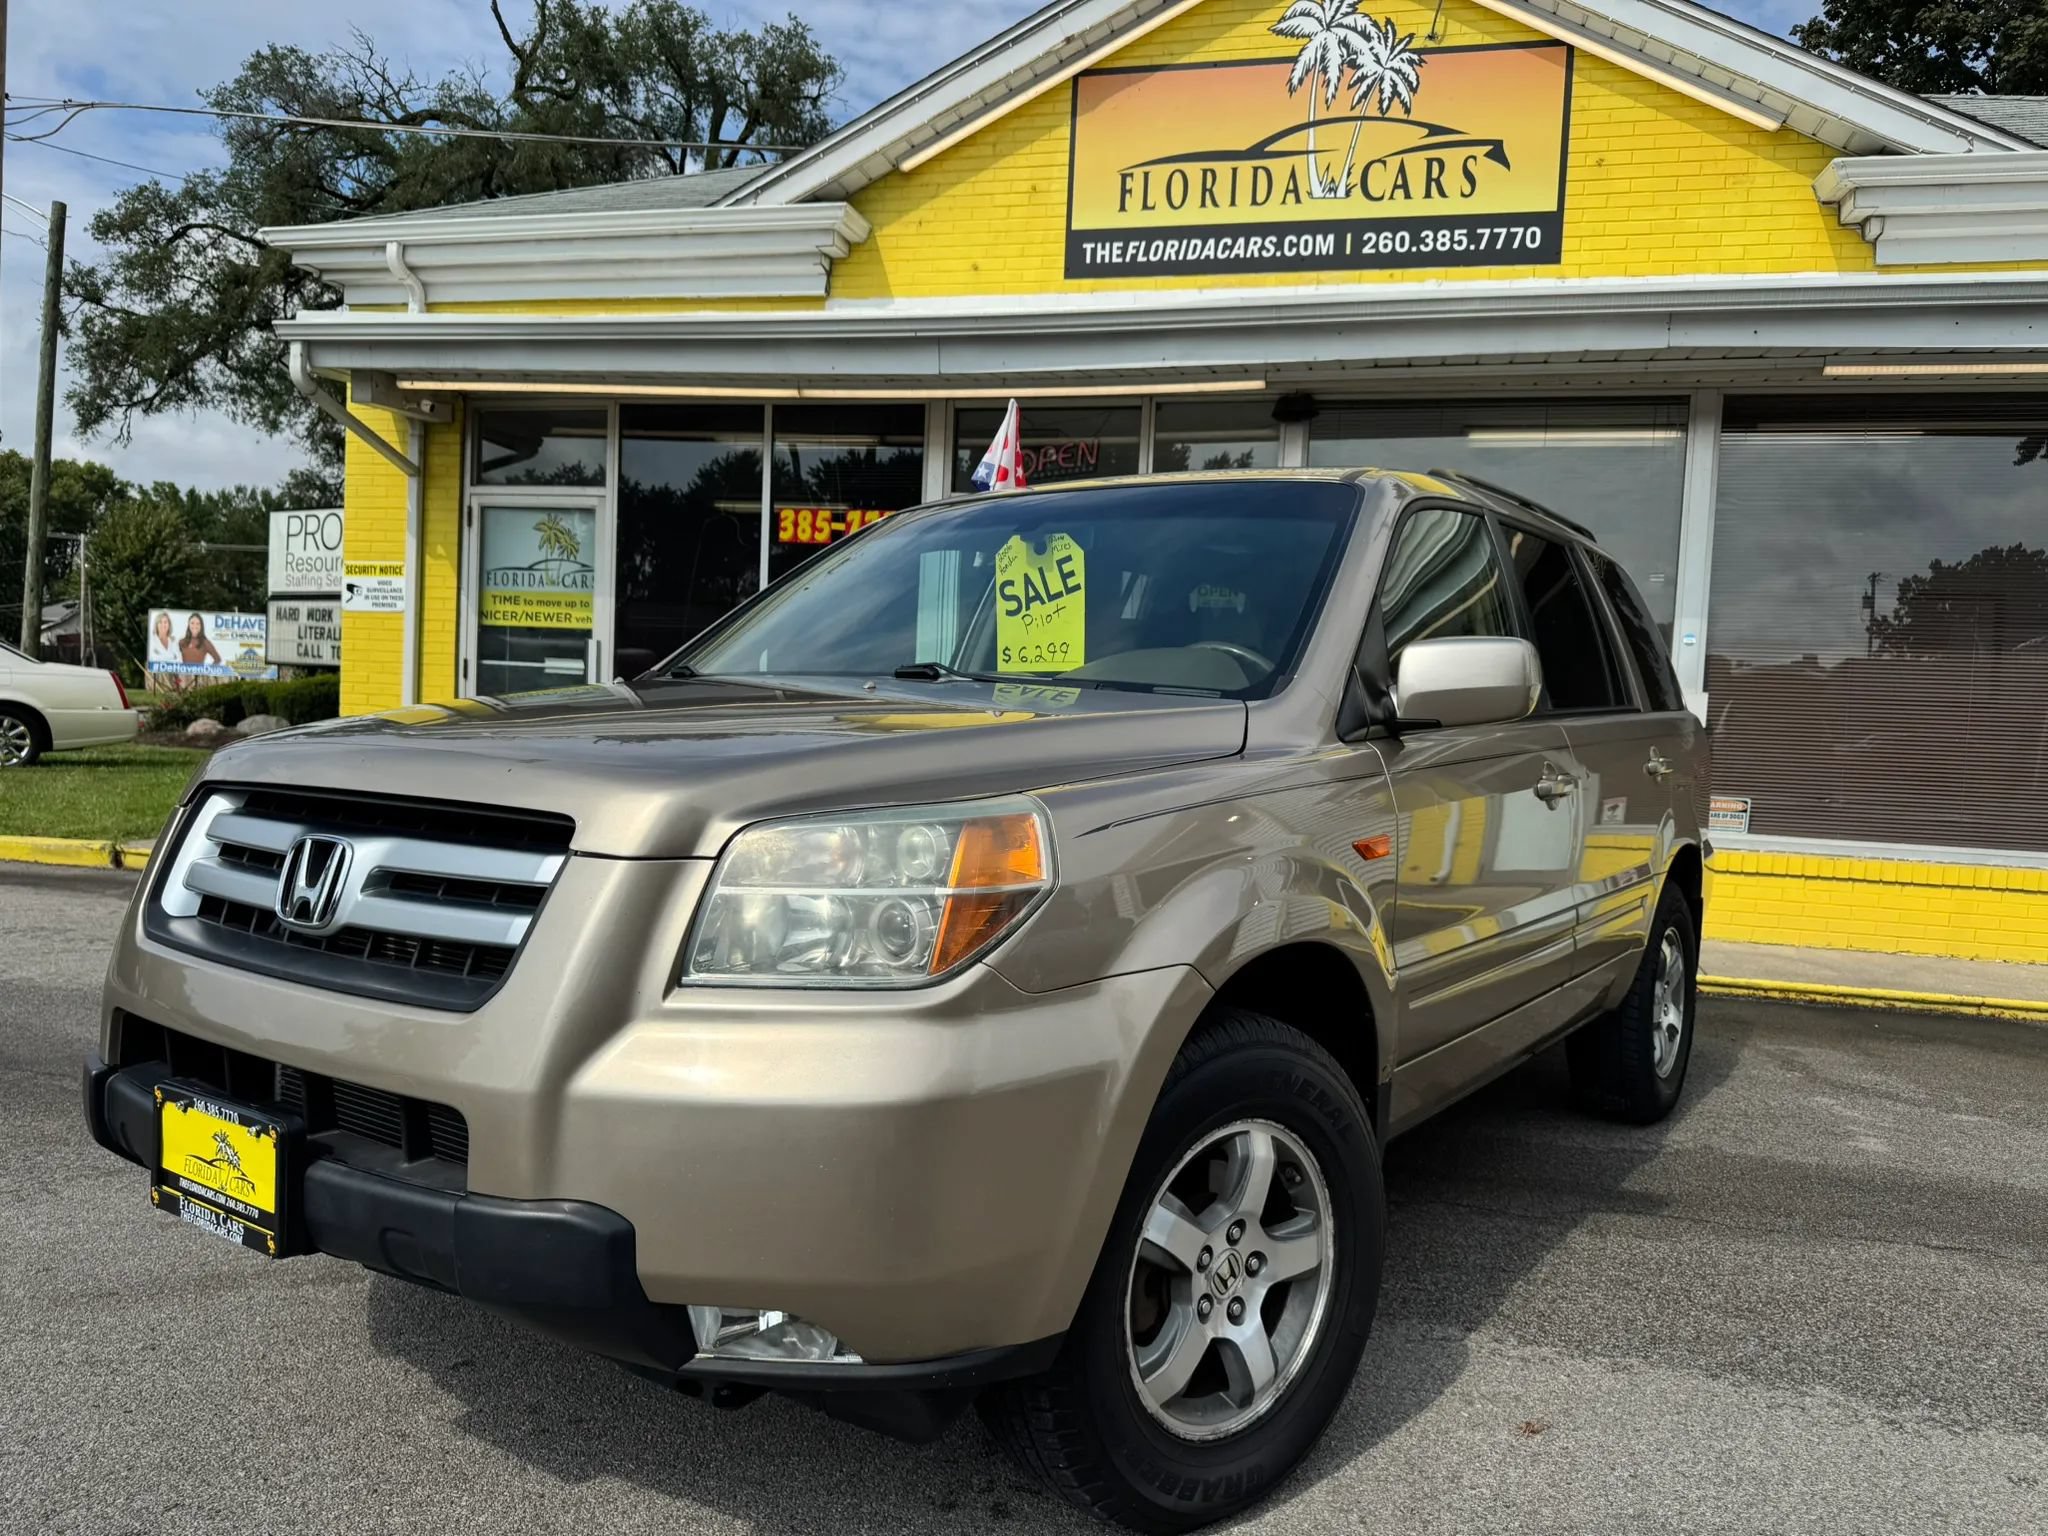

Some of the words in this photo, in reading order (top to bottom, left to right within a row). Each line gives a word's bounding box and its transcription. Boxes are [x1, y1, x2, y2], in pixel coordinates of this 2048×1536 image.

[1118, 164, 1302, 213] FLORIDA
[1360, 154, 1478, 202] CARS
[1082, 233, 1335, 265] THEFLORIDACARS.COM
[1362, 226, 1542, 254] 260.385.7770
[286, 512, 343, 551] PRO
[286, 552, 343, 573] Resour
[345, 564, 378, 577] SECURITY
[379, 564, 404, 577] NOTICE
[486, 571, 545, 588] FLORIDA
[999, 554, 1082, 617] SALE
[276, 606, 300, 621] HARD
[307, 607, 334, 622] WORK
[491, 594, 521, 606] TIME
[523, 597, 534, 607] to
[536, 600, 562, 608] move
[564, 600, 577, 609] up
[580, 599, 590, 609] to
[481, 609, 573, 623] NICER/NEWER
[1021, 603, 1067, 635] Pilot
[297, 643, 323, 658] CALL
[153, 662, 223, 675] #DeHavenDuo
[193, 1098, 240, 1125] 260.385.7770
[184, 1158, 218, 1185] FLORIDA
[229, 1177, 251, 1198] CARS
[180, 1196, 217, 1224] FLORIDA
[220, 1213, 245, 1236] CARS
[180, 1210, 243, 1245] THEFLORIDACARS.COM
